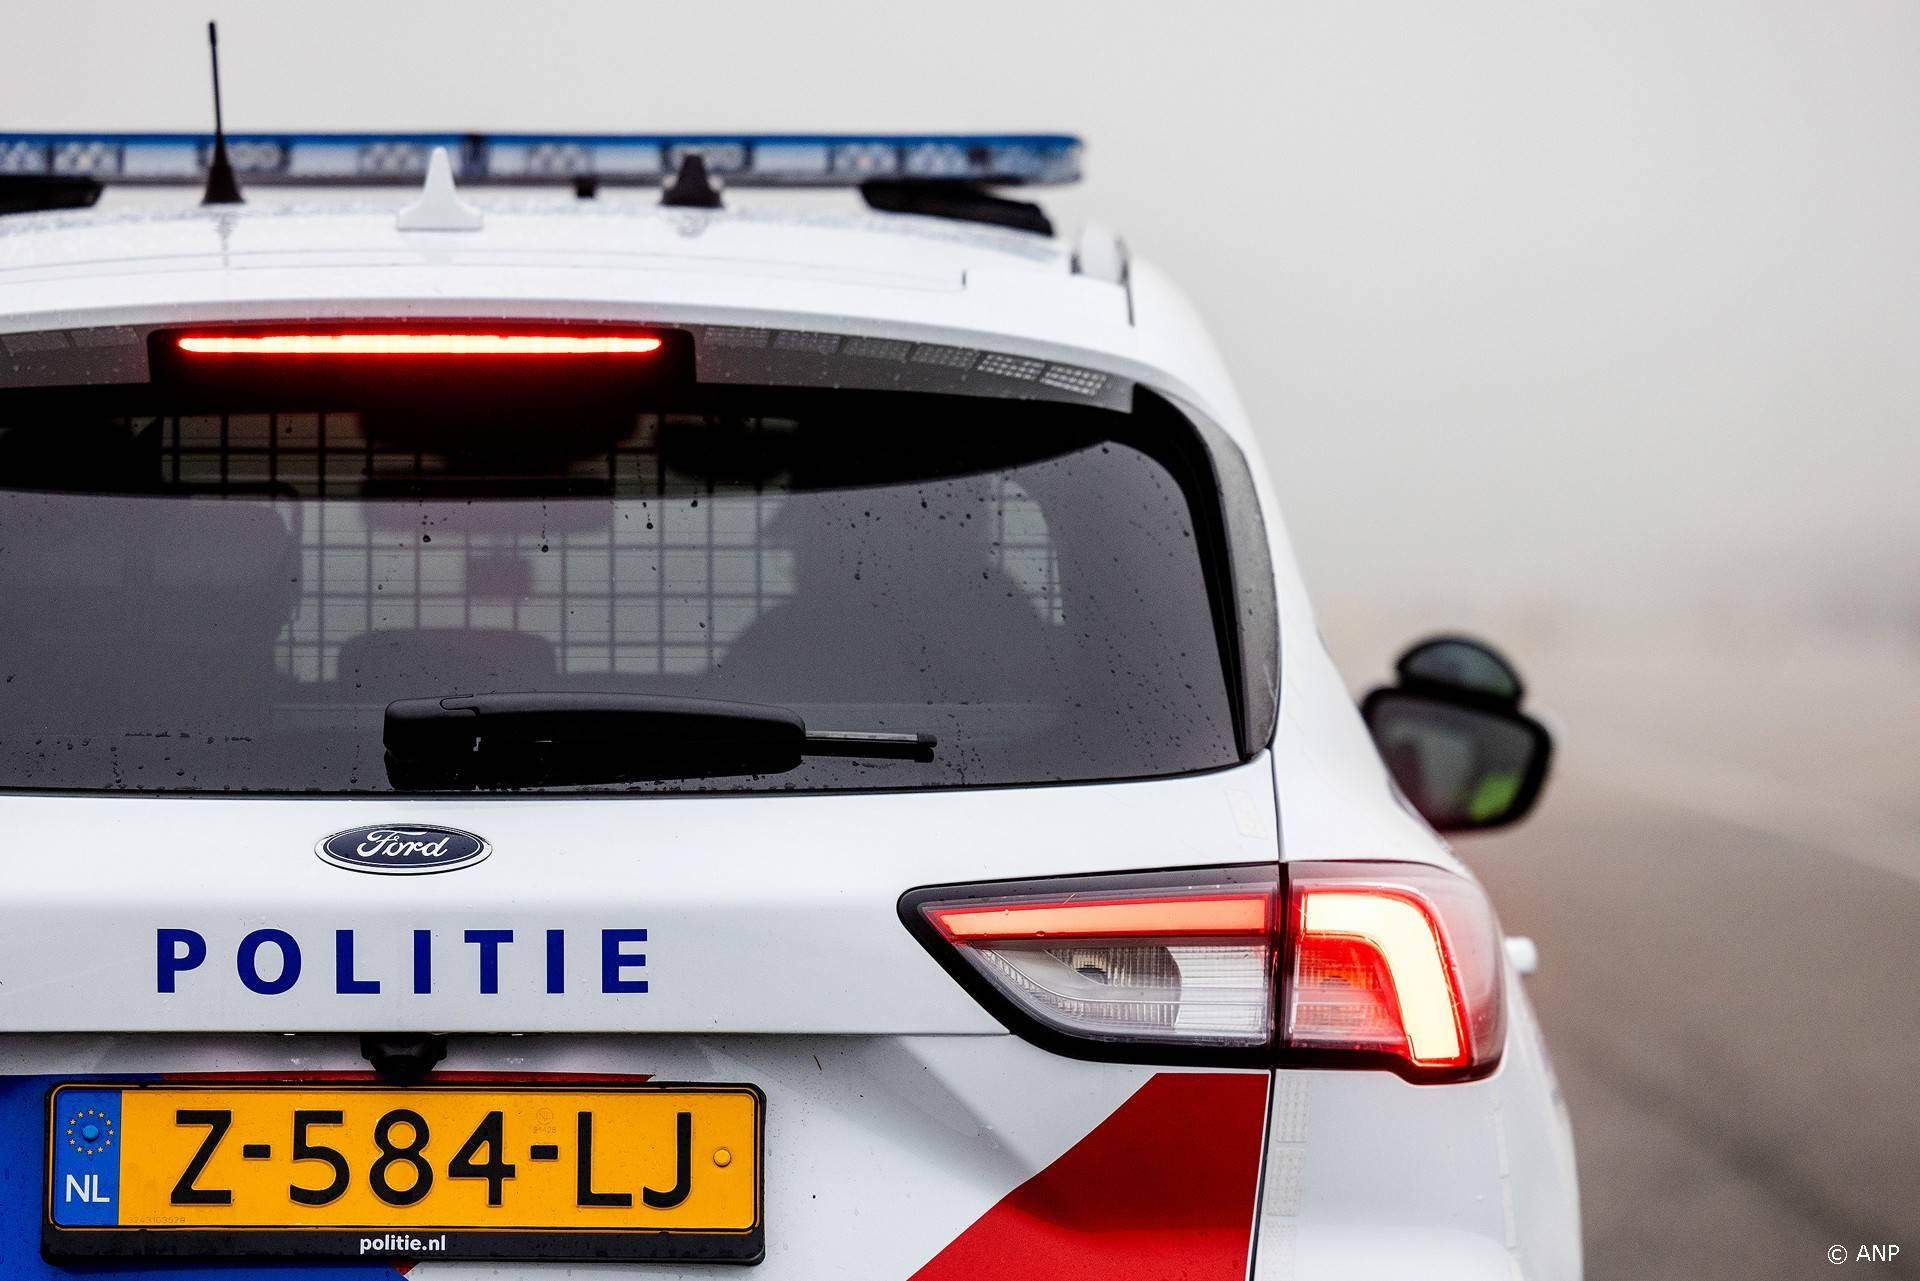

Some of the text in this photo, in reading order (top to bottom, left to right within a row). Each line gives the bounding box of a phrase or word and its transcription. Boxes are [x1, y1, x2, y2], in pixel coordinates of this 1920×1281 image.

[357, 829, 450, 857] Ford
[156, 928, 649, 995] POLITIE
[170, 1108, 692, 1209] Z-584-LJ
[65, 1174, 111, 1203] NL
[359, 1234, 446, 1255] politie.nl
